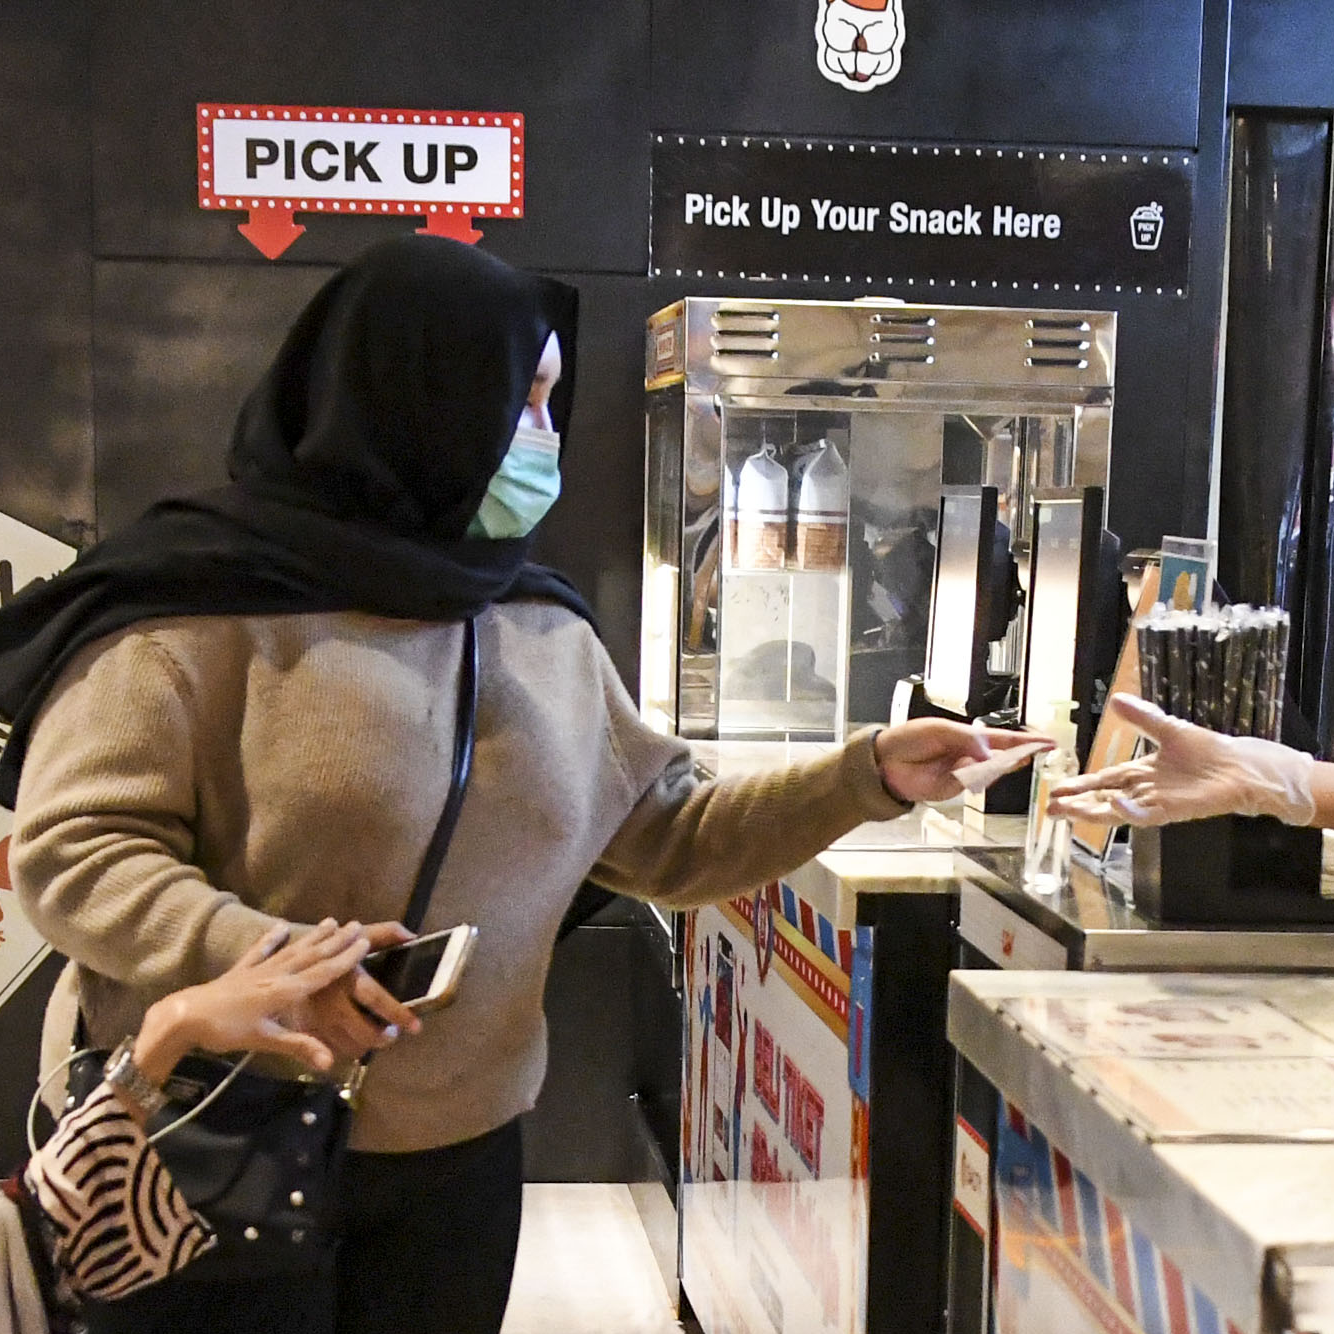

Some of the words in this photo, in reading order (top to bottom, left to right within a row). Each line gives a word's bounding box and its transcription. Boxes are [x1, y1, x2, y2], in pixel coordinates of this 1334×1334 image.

[244, 138, 383, 183] PICK
[403, 142, 479, 184] UP
[684, 192, 751, 227] Pick
[761, 197, 801, 235] Up
[810, 198, 880, 232] Your
[888, 201, 983, 236] Snack
[992, 204, 1062, 239] Here
